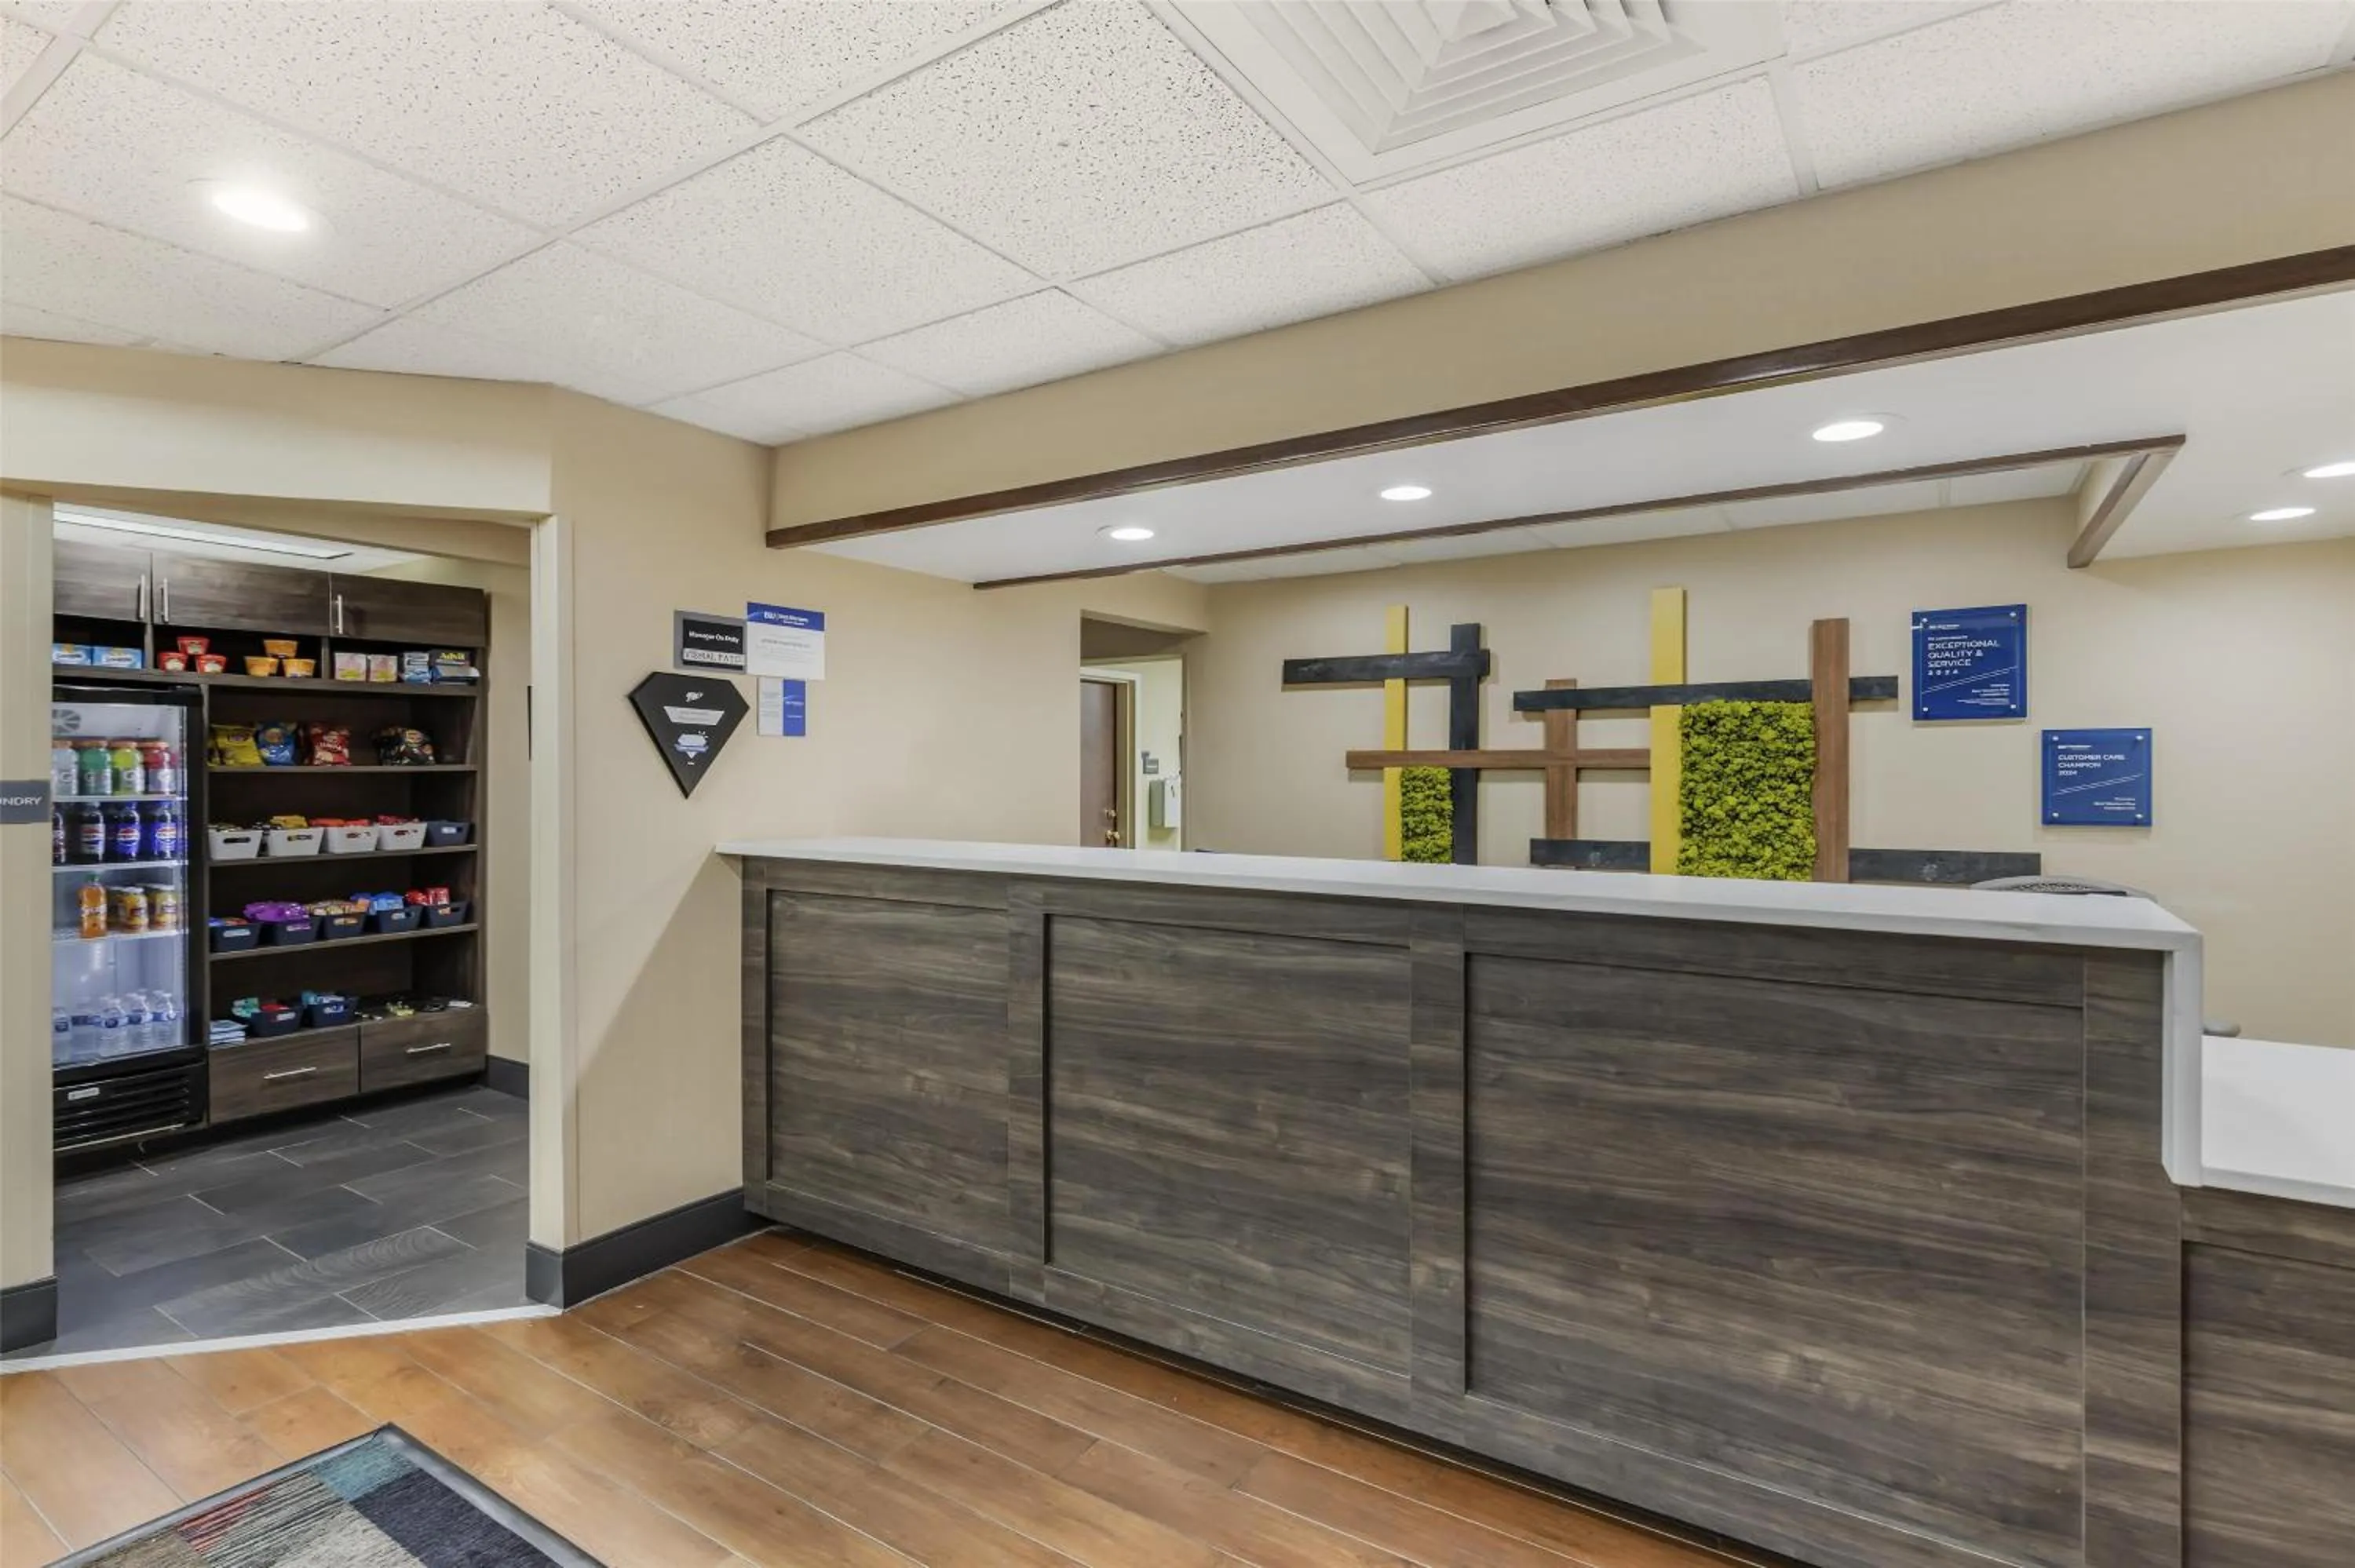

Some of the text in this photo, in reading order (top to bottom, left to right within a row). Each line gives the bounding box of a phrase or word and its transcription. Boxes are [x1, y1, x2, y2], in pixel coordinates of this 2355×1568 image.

[1928, 640, 2000, 651] EXCEPTIONAL
[1928, 650, 1973, 659] QUALITY
[1928, 658, 1972, 668] SERVICE
[0, 796, 42, 806] NDRY
